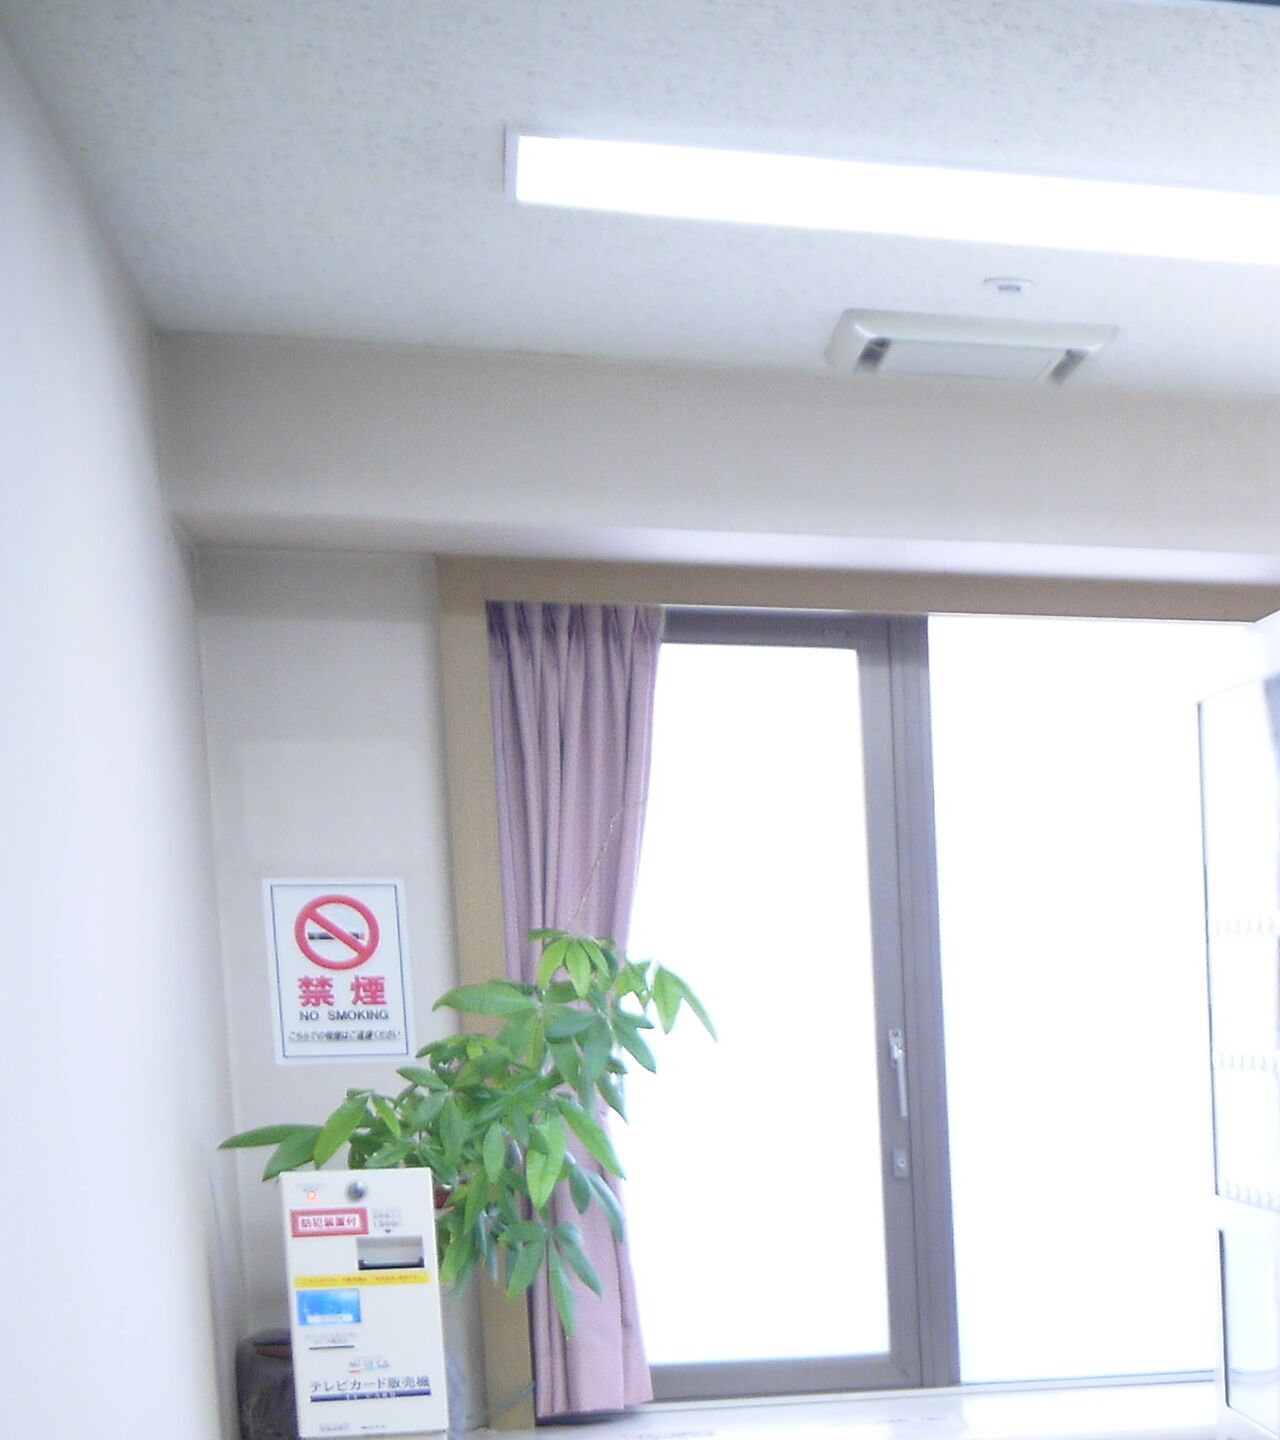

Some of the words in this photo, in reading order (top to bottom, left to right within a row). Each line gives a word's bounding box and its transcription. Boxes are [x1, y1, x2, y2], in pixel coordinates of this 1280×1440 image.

[297, 974, 388, 1007] 禁煙
[299, 1009, 319, 1021] NO
[327, 1007, 389, 1021] SMOKING
[311, 1375, 431, 1393] テレビカード販売機
